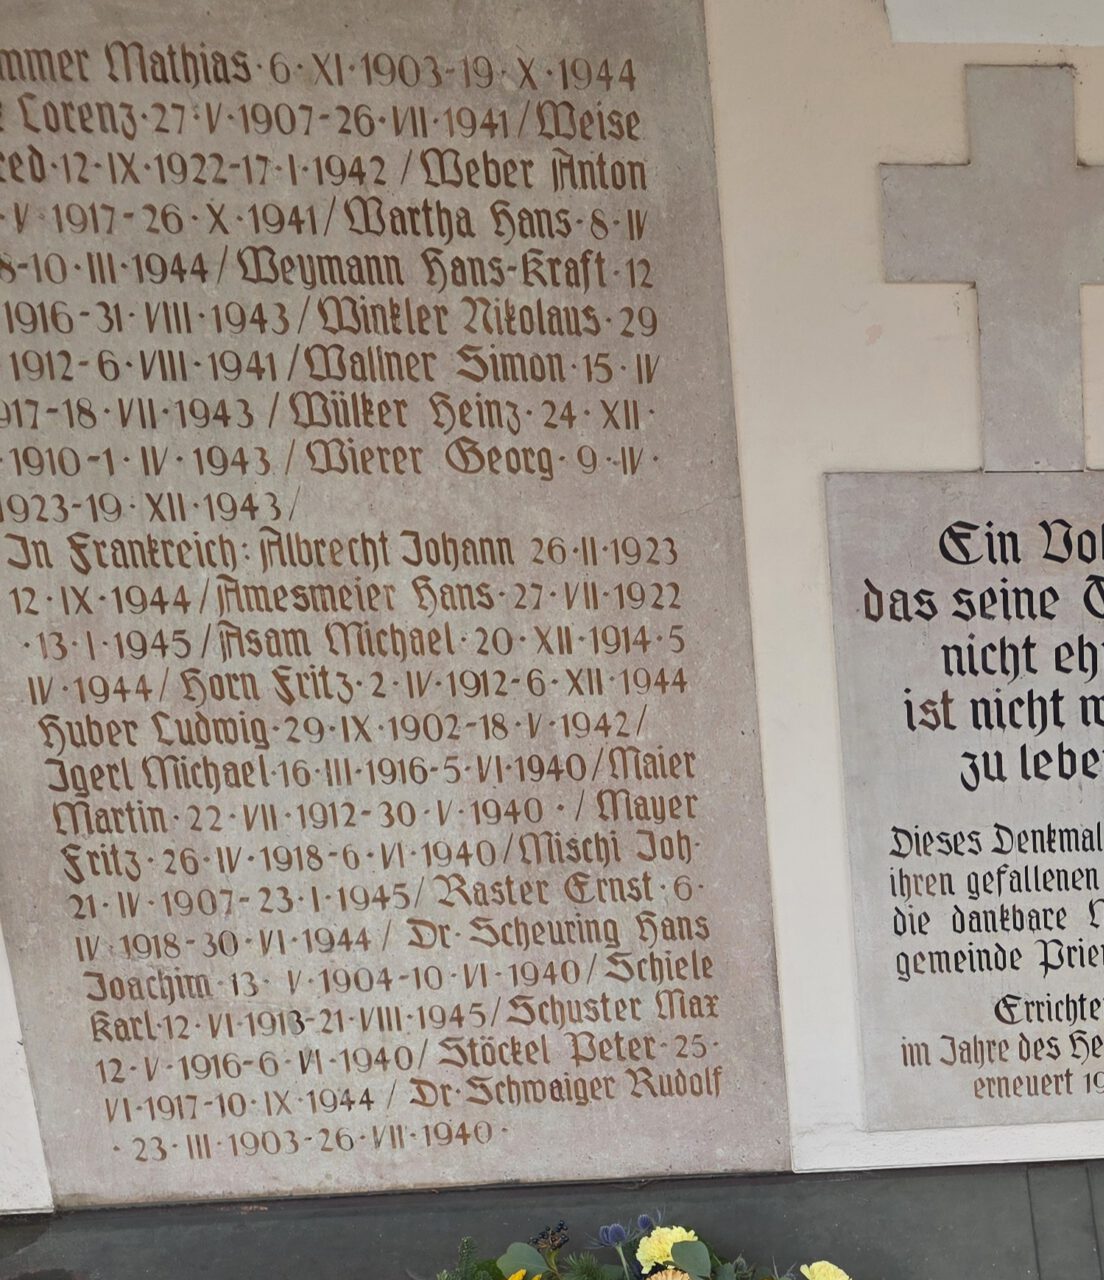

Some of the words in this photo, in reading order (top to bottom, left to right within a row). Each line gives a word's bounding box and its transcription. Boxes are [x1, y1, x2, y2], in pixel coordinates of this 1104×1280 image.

[939, 521, 1021, 566] Ein
[864, 578, 938, 623] das
[952, 577, 1060, 622] seine
[941, 632, 1038, 685] nicht
[904, 688, 957, 732] ist
[970, 688, 1065, 737] nicht
[961, 750, 1007, 792] zu
[889, 825, 982, 859] Dieses
[991, 821, 1103, 855] Denkmal
[890, 867, 955, 903] ihren
[967, 863, 1099, 900] gefallenen
[894, 904, 930, 937] die
[952, 904, 1067, 934] dankbare
[896, 942, 1022, 982] gemeinde
[901, 1036, 931, 1067] im
[940, 1034, 1009, 1069] Jahre
[1019, 1032, 1061, 1062] des
[974, 1068, 1073, 1099] erneuert
